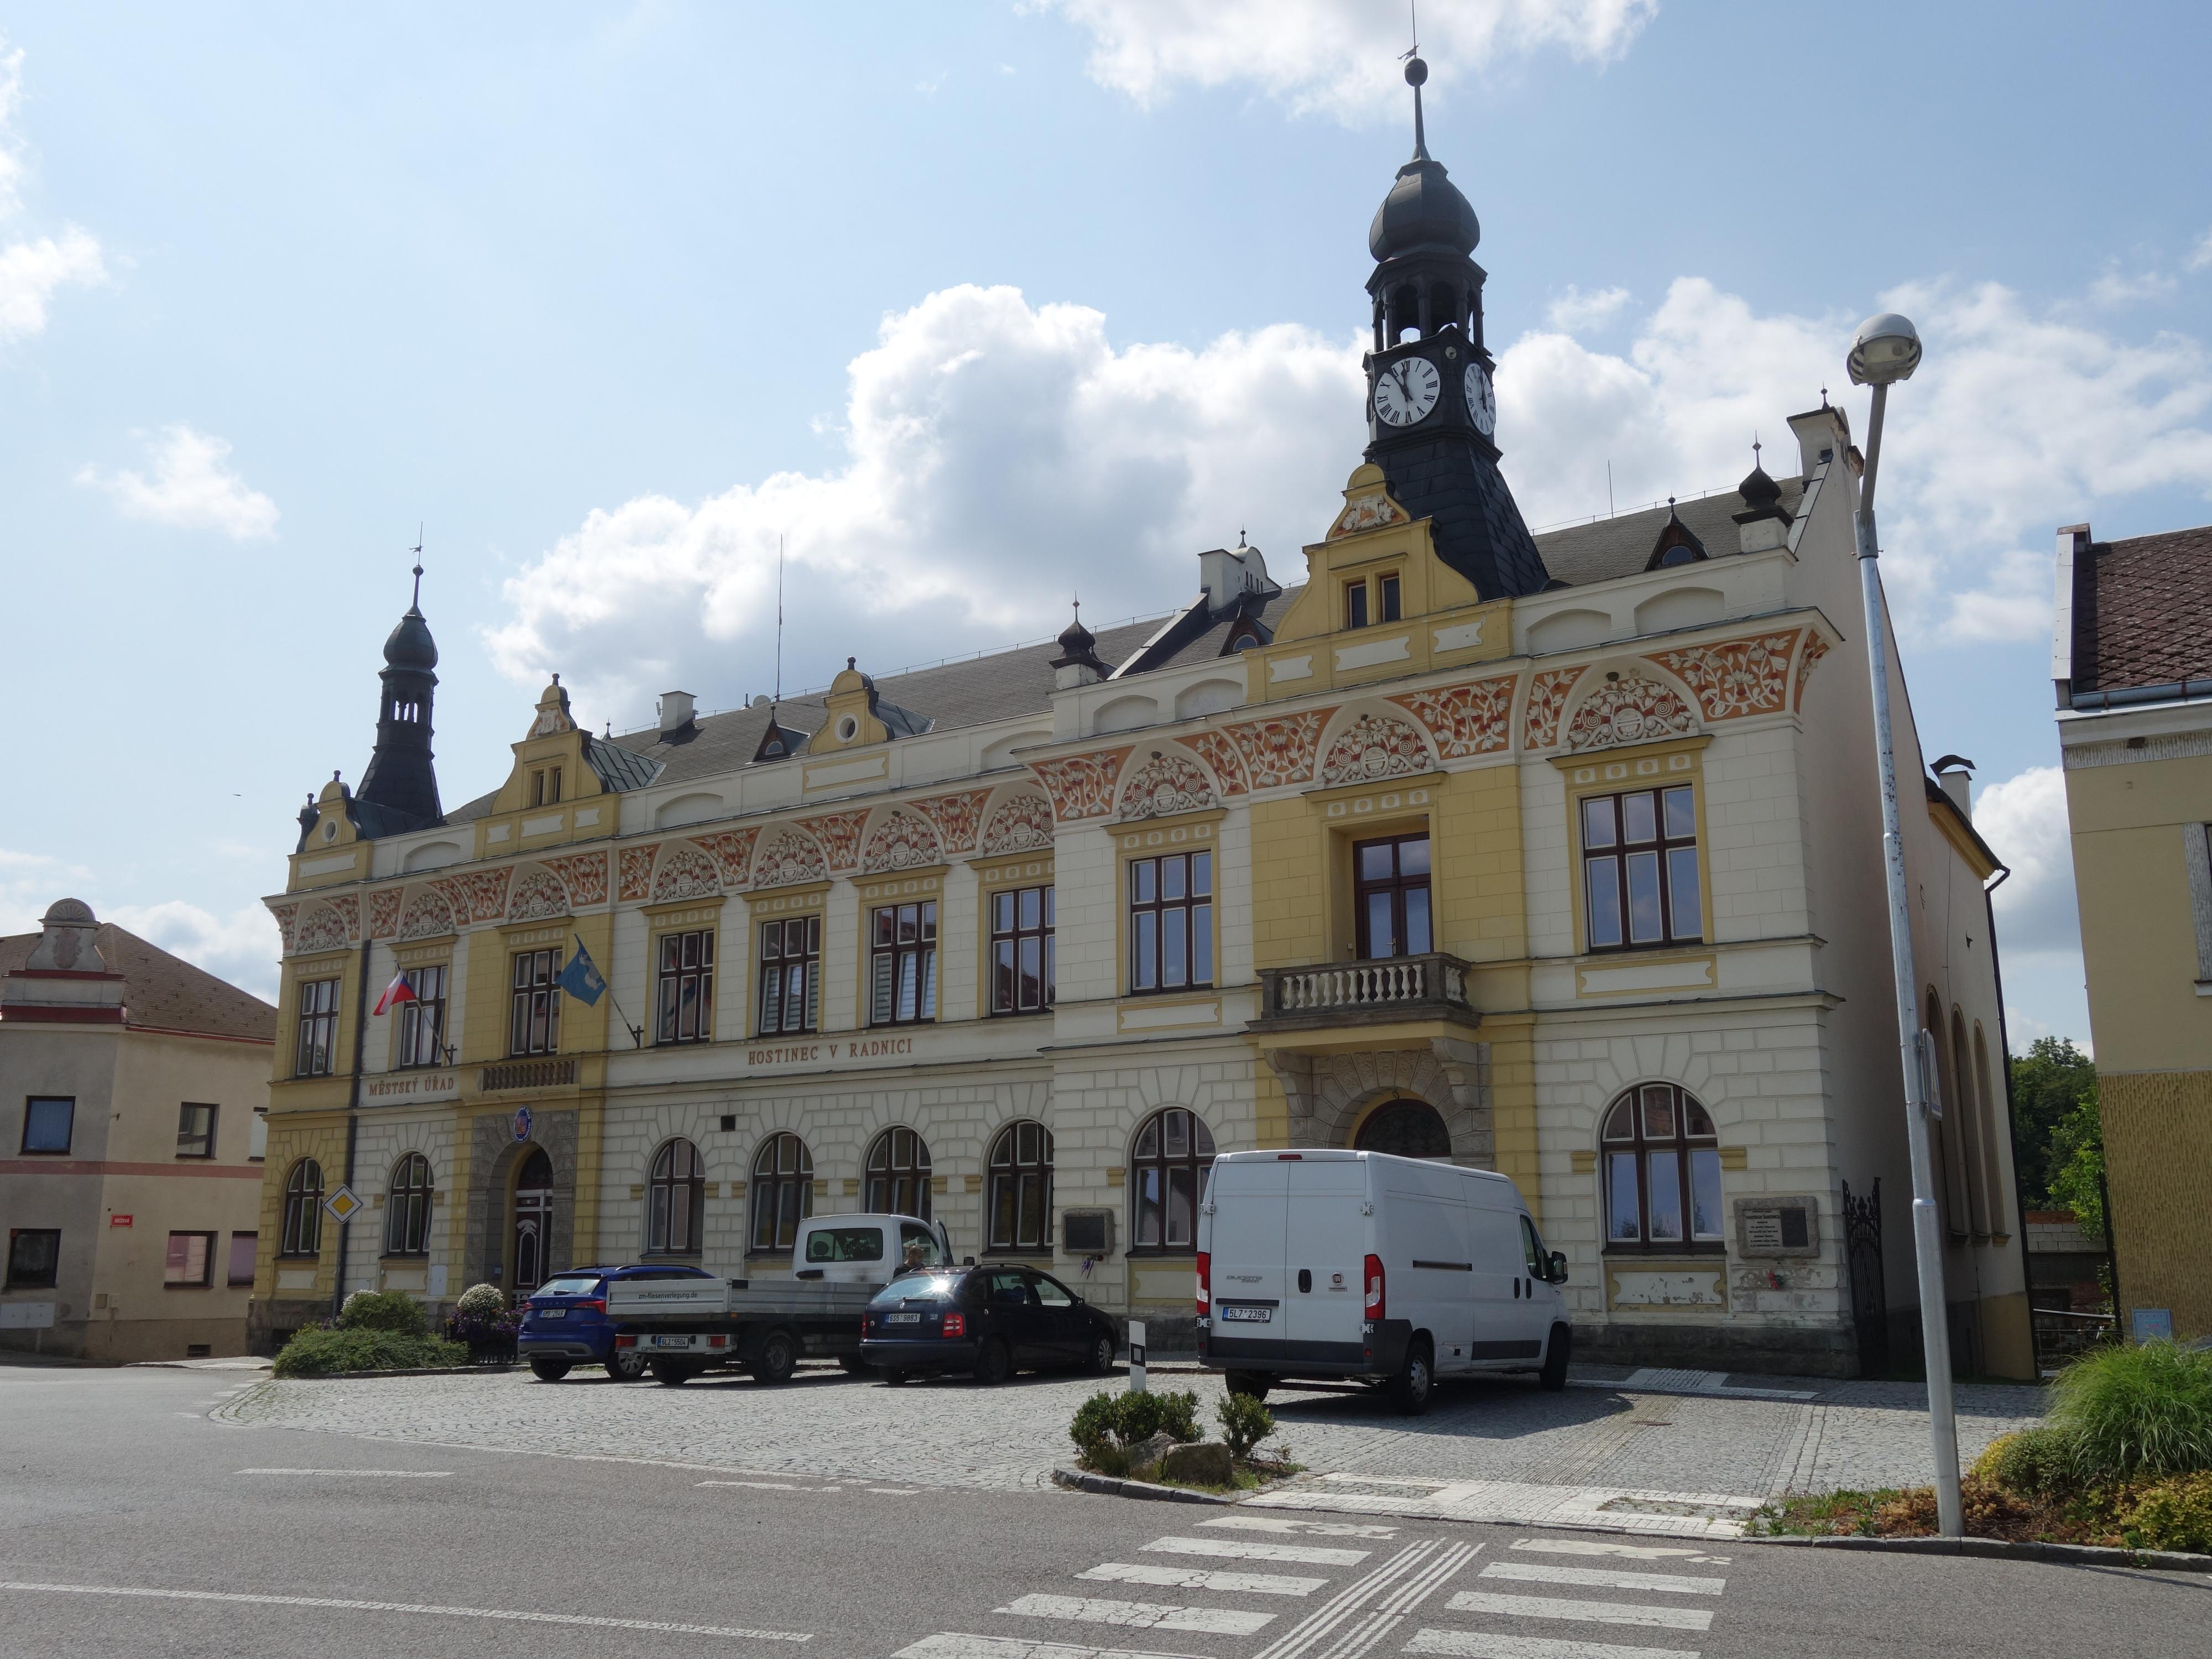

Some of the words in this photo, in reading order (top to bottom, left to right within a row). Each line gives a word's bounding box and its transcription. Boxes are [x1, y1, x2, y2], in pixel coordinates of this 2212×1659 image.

[1415, 361, 1422, 372] I
[1422, 367, 1434, 378] II
[1426, 380, 1438, 389] III
[1377, 394, 1389, 404] IX
[1379, 403, 1392, 418] VIII
[1416, 405, 1426, 416] V
[1389, 410, 1400, 424] VII
[1405, 411, 1412, 424] VI
[748, 1046, 818, 1065] HOSTINEC
[829, 1045, 838, 1058] V
[849, 1039, 912, 1057] RADNICI
[368, 1077, 418, 1096] MĚSTSKÝ
[425, 1076, 454, 1092] ÚŘAD
[638, 1291, 697, 1300] zm-fliesenverlegung.de
[1229, 1309, 1243, 1318] 5L7
[1248, 1310, 1266, 1318] 2396
